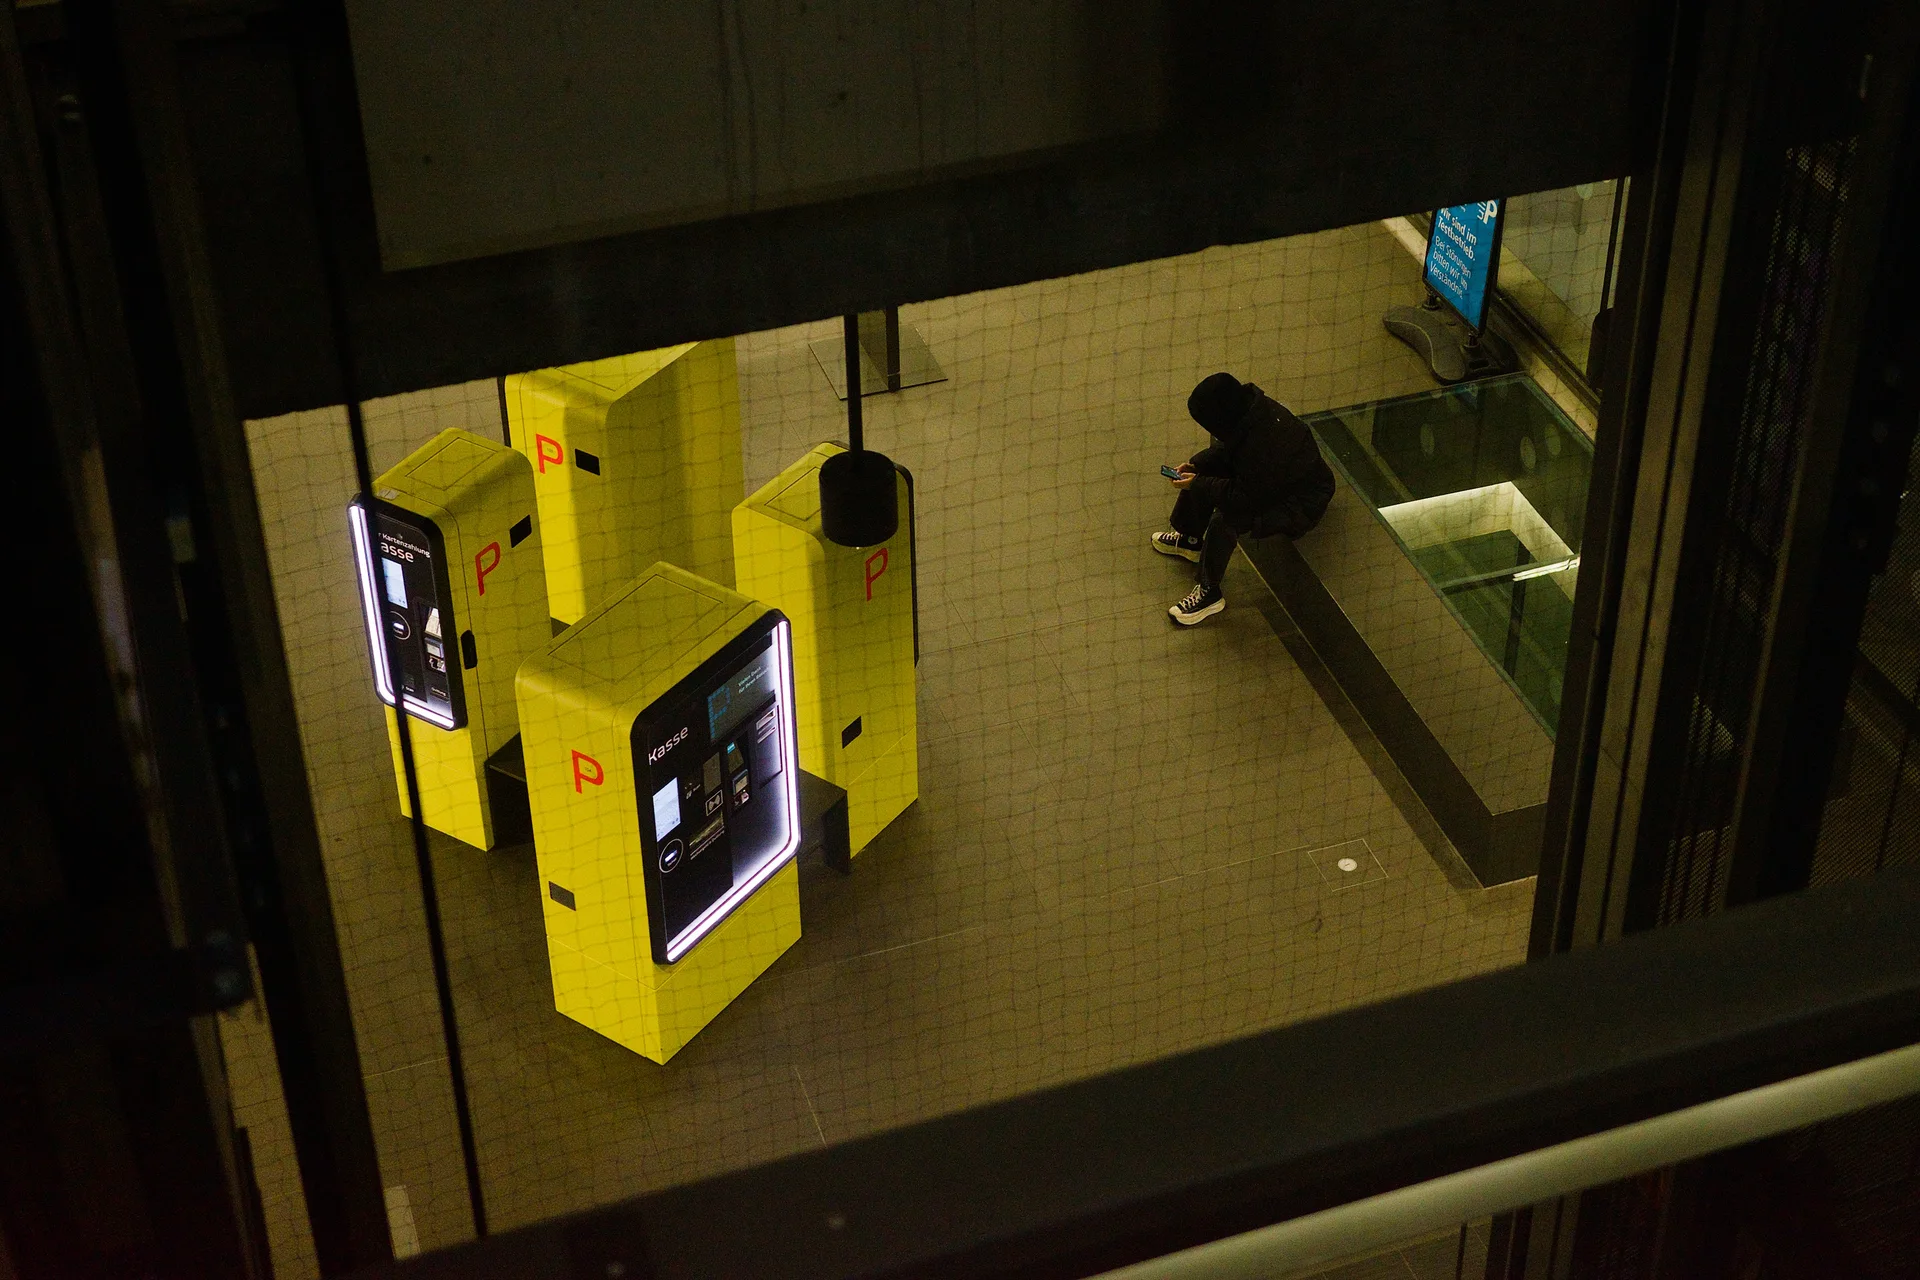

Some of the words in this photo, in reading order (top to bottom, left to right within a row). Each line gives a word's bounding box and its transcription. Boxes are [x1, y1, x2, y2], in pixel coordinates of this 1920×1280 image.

[1437, 215, 1476, 261] Testbetrieb.
[1452, 216, 1466, 237] sind
[1466, 228, 1477, 246] im
[1432, 248, 1449, 272] bitten
[1449, 260, 1460, 279] wir
[1435, 235, 1446, 251] Bei
[1446, 244, 1471, 279] Störungen
[535, 433, 564, 475] P
[380, 541, 414, 563] asse
[382, 532, 431, 559] Kartenzahlung
[474, 541, 500, 597] P
[865, 547, 889, 602] P
[648, 726, 689, 766] Kasse
[571, 749, 605, 795] P
